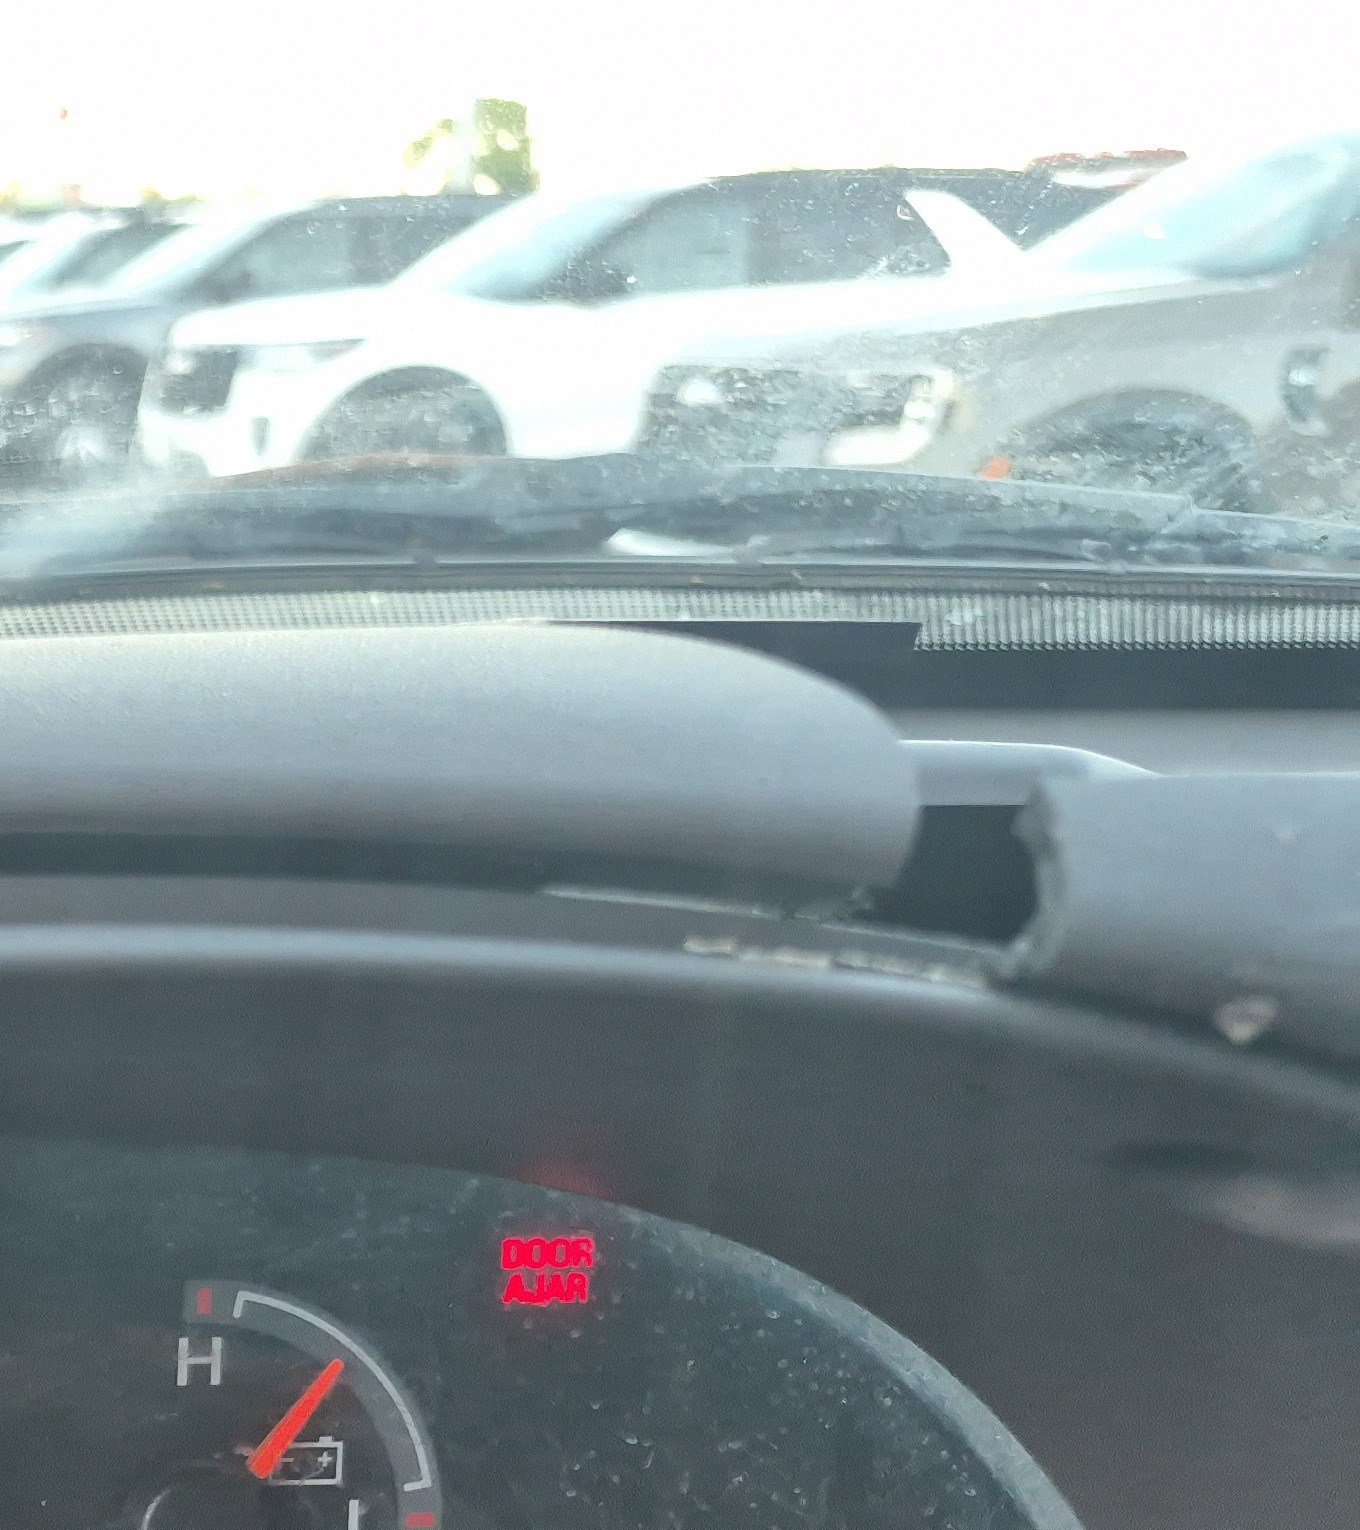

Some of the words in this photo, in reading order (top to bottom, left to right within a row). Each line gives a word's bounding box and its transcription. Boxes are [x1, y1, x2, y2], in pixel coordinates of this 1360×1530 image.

[501, 1237, 595, 1270] DOOR
[501, 1273, 590, 1306] AJAR
[176, 1336, 223, 1387] H
